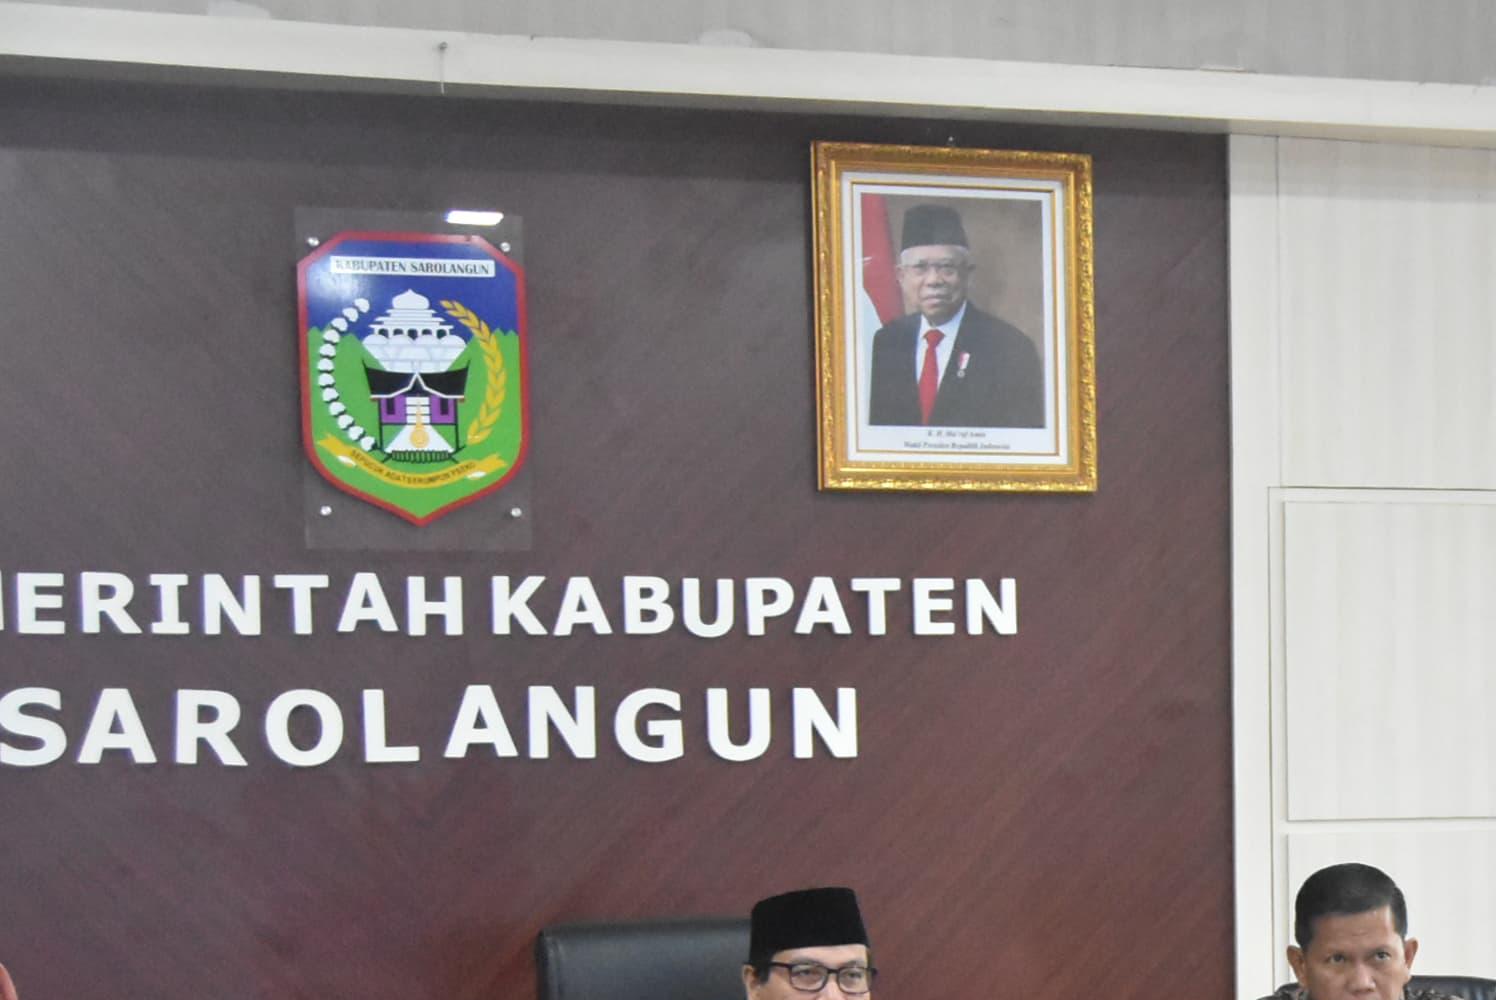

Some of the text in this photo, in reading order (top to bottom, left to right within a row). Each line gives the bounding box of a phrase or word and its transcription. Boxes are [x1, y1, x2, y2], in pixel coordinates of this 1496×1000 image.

[410, 261, 489, 275] SAROLANGUN
[0, 569, 1018, 638] ERINTAH KABUPATEN
[0, 684, 859, 767] SAROLANGUN
